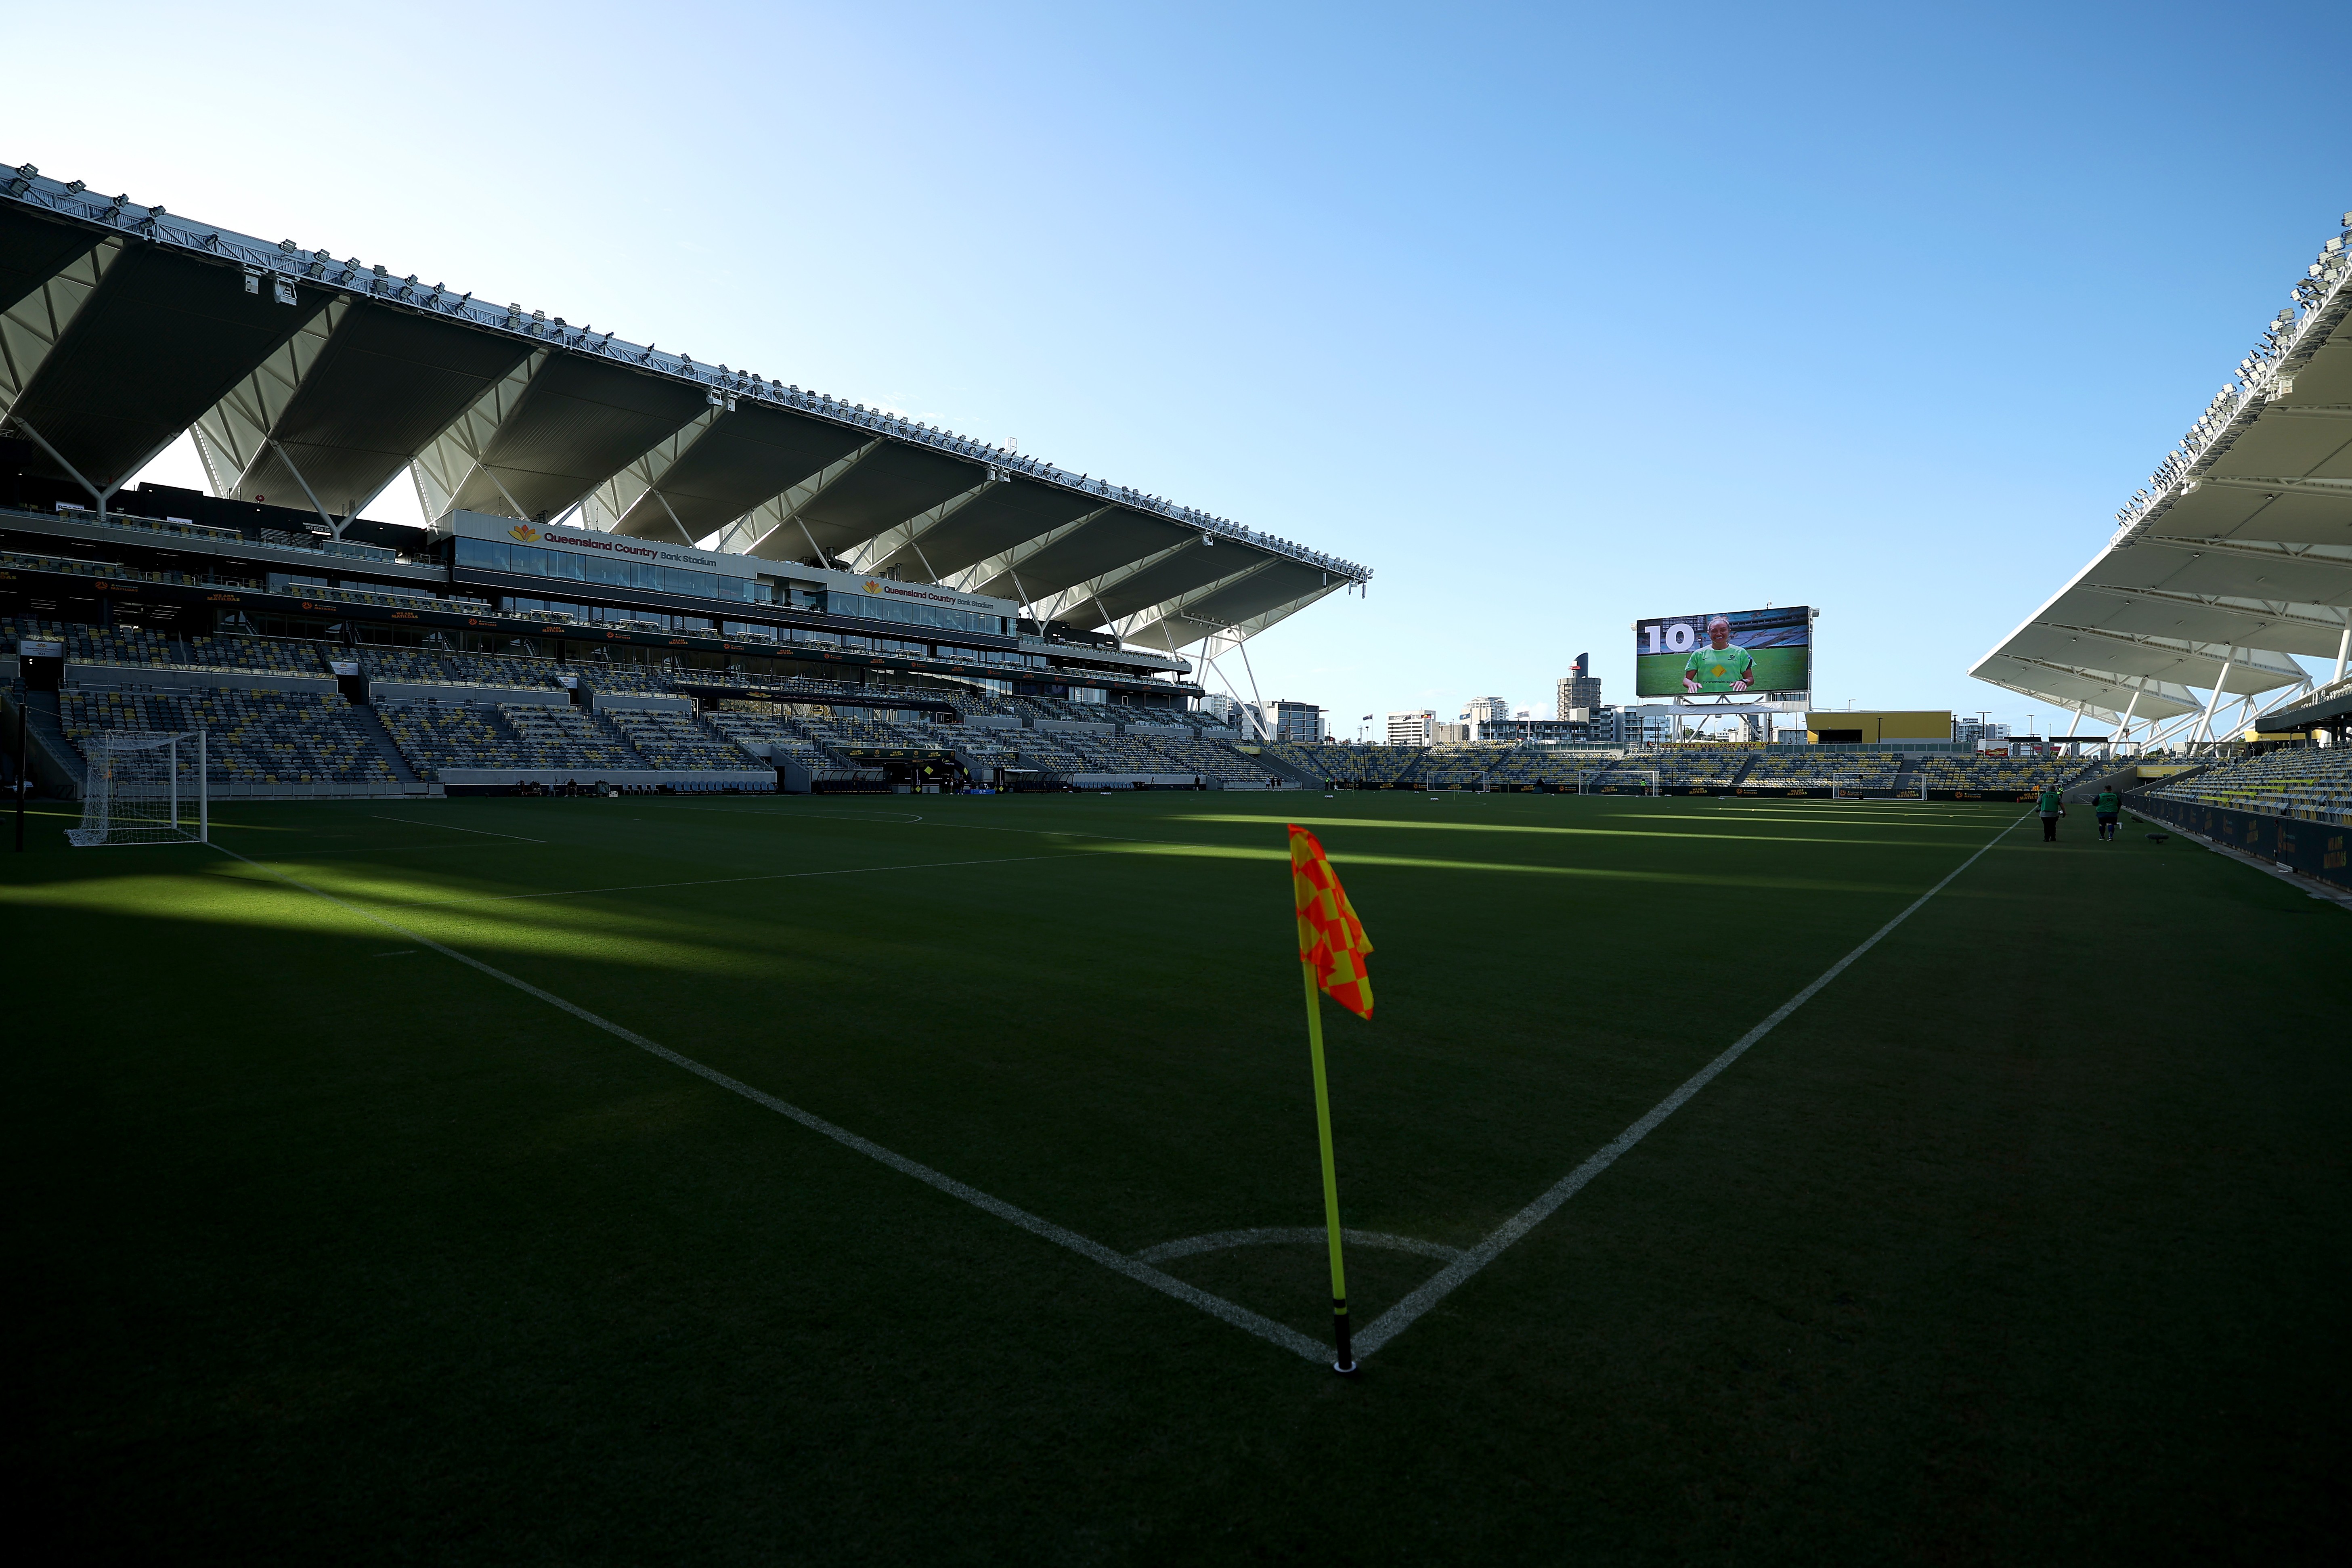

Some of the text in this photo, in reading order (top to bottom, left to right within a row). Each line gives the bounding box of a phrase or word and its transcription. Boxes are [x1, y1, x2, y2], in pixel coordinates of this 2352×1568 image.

[544, 532, 716, 567] Queensland Country Bank Stadium
[884, 586, 927, 599] Queensland
[929, 593, 956, 605] Country
[971, 601, 994, 609] Stadium
[1645, 623, 1695, 653] 10
